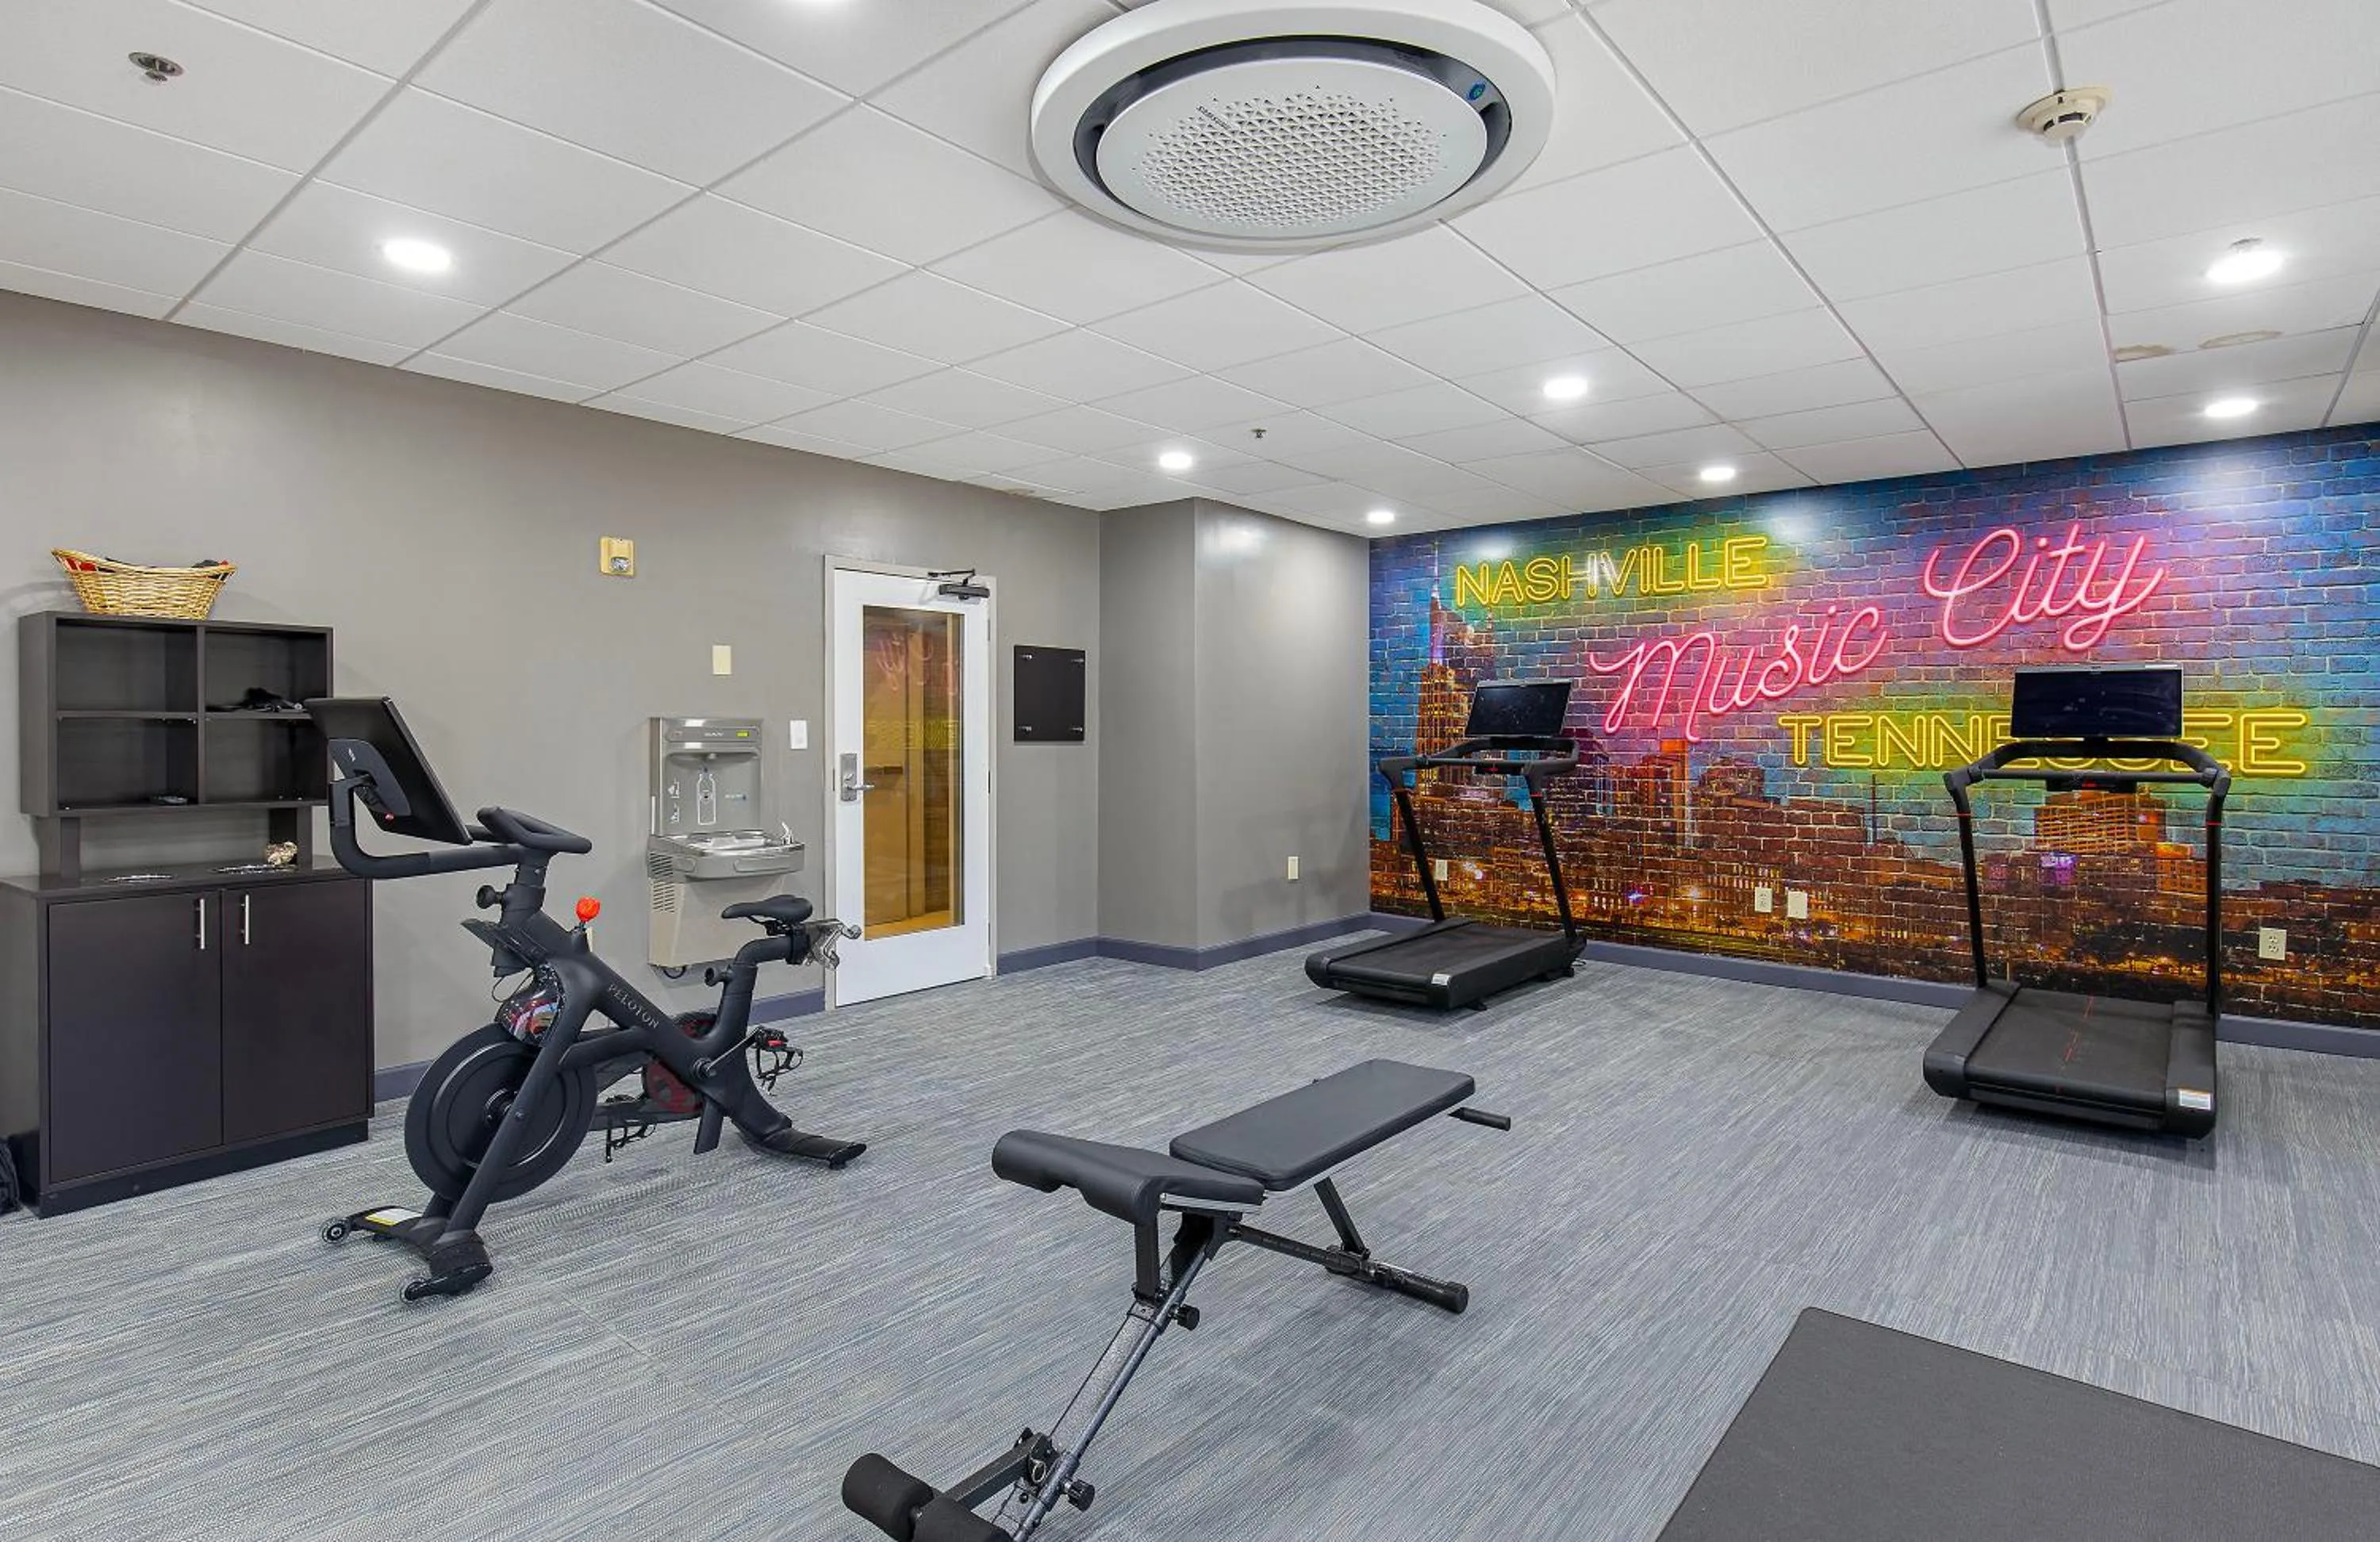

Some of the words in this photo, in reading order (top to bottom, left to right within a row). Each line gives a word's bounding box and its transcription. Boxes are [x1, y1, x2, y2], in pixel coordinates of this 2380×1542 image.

[1457, 535, 1768, 608] NASHVILLE
[1589, 604, 1888, 743] Music
[1923, 523, 2165, 650] City
[1777, 712, 2307, 774] TENNEEE
[608, 984, 659, 1028] PELOTON
